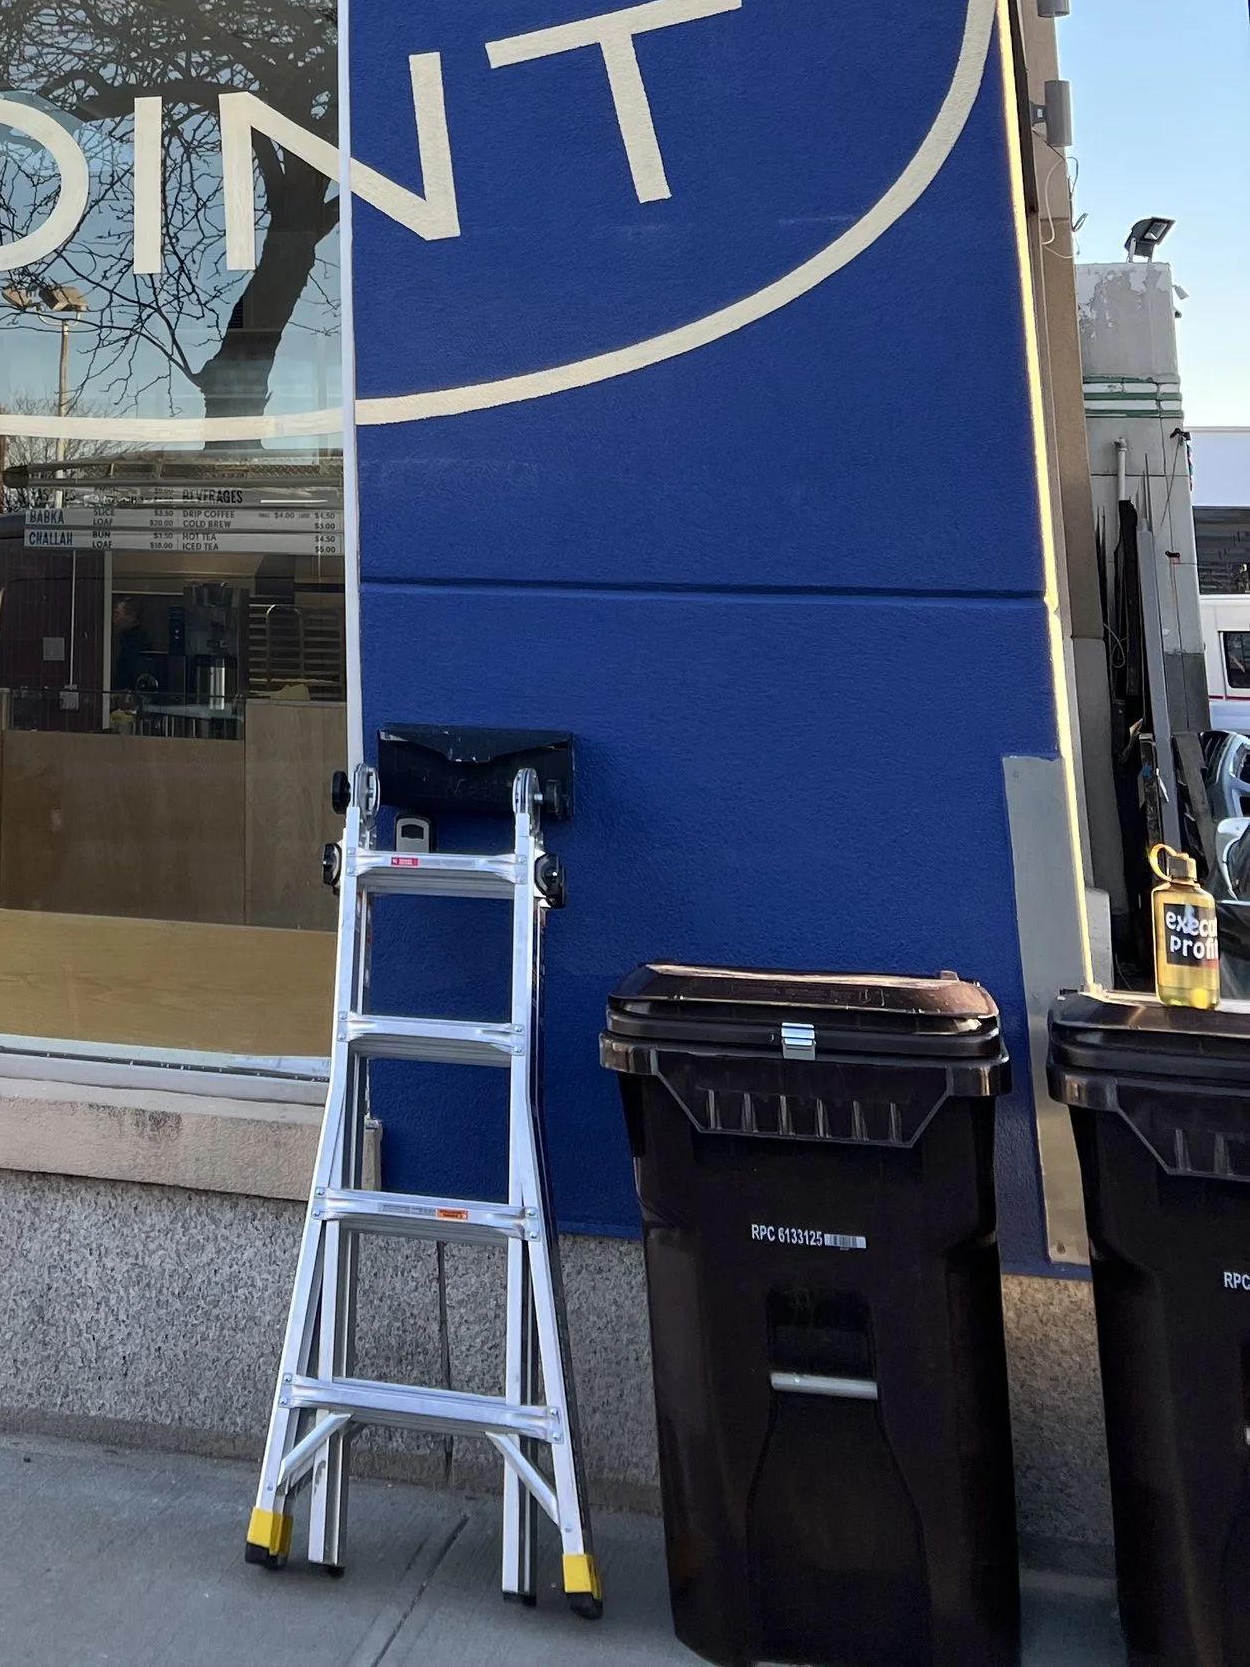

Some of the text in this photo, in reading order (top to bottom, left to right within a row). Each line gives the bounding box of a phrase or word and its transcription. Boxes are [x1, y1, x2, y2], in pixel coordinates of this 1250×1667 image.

[29, 509, 65, 524] BABKA
[29, 532, 73, 546] CHALLAH
[751, 1223, 823, 1247] RPC 6133125
[1224, 1271, 1250, 1291] RPC
